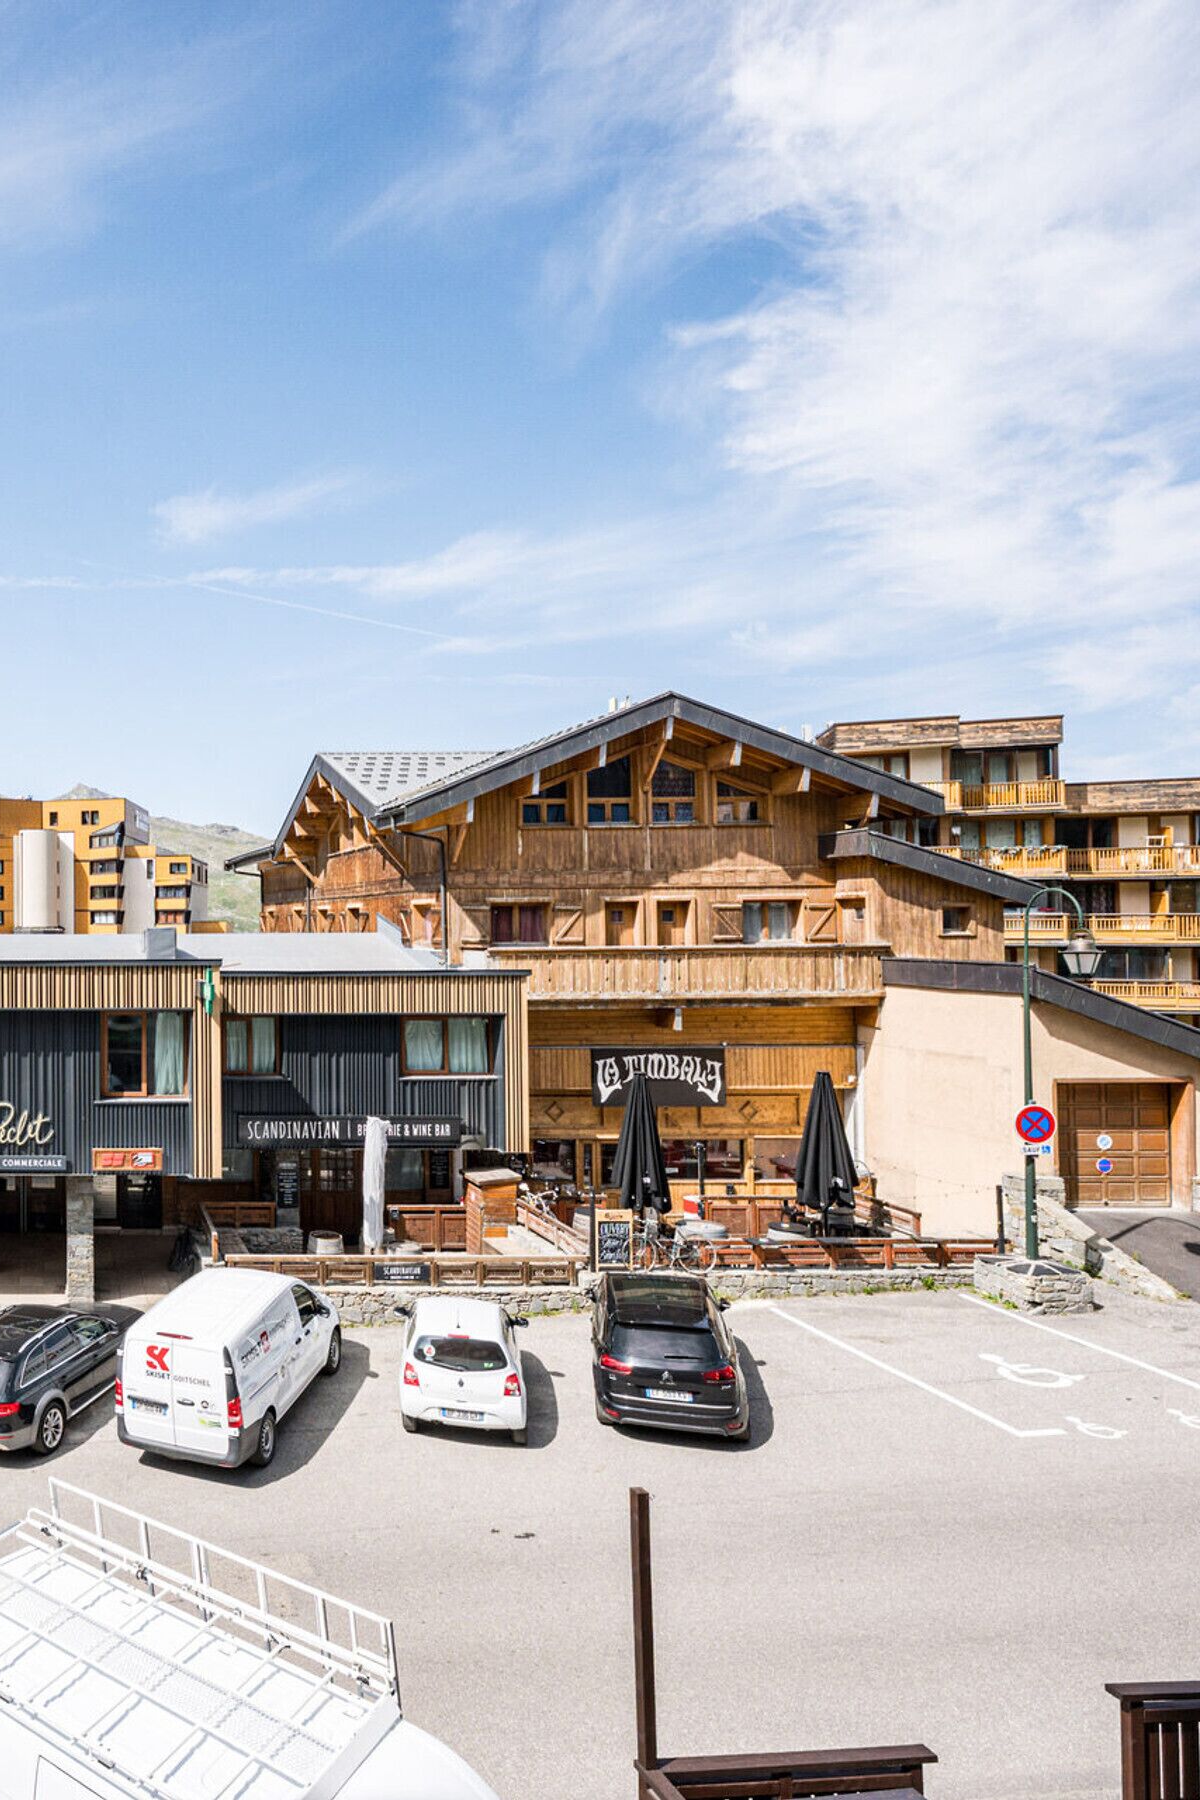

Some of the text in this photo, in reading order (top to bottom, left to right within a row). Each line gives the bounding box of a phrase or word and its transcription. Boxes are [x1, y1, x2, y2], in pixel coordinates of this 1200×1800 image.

[595, 1053, 723, 1104] LA TIMBALE
[247, 1120, 340, 1140] SCANDINAVIAN
[404, 1123, 411, 1136] &
[412, 1123, 432, 1137] WINE
[435, 1123, 451, 1137] BAR
[2, 1159, 62, 1167] COMMERCIALE
[146, 1370, 171, 1381] SKISET
